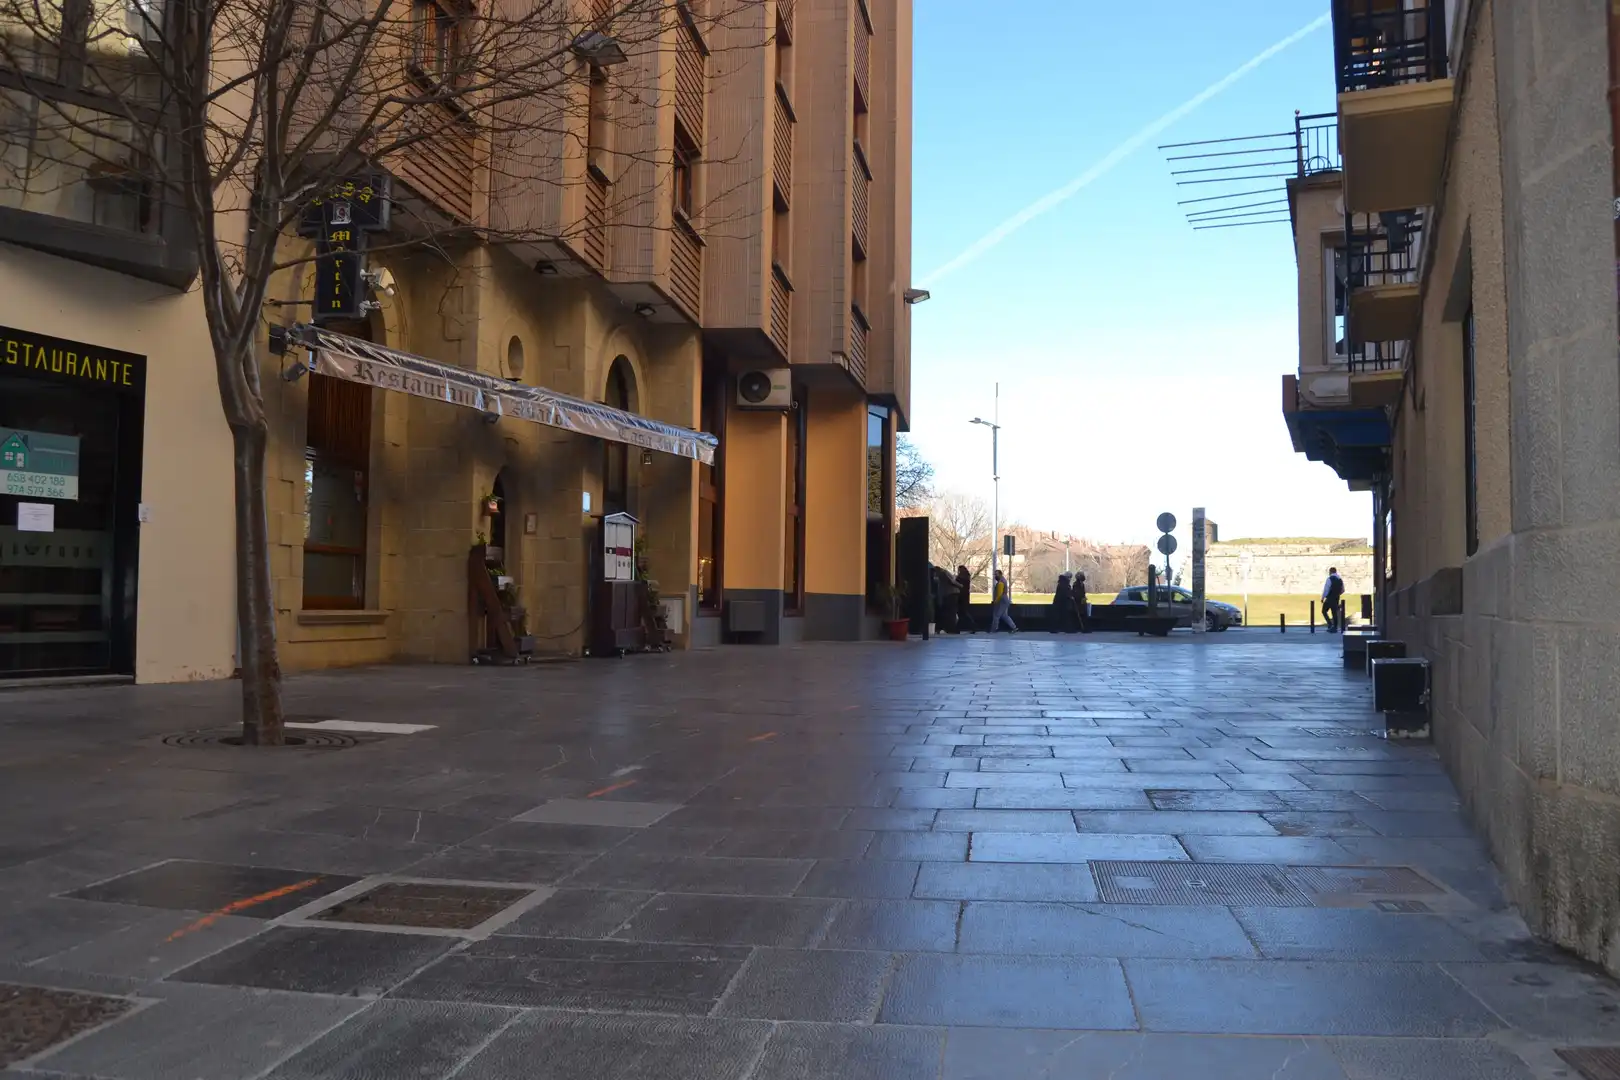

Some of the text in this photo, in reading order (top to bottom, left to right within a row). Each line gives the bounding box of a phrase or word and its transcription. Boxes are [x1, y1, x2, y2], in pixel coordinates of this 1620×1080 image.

[28, 474, 47, 485] 402
[7, 484, 25, 494] 974
[27, 485, 44, 496] 579
